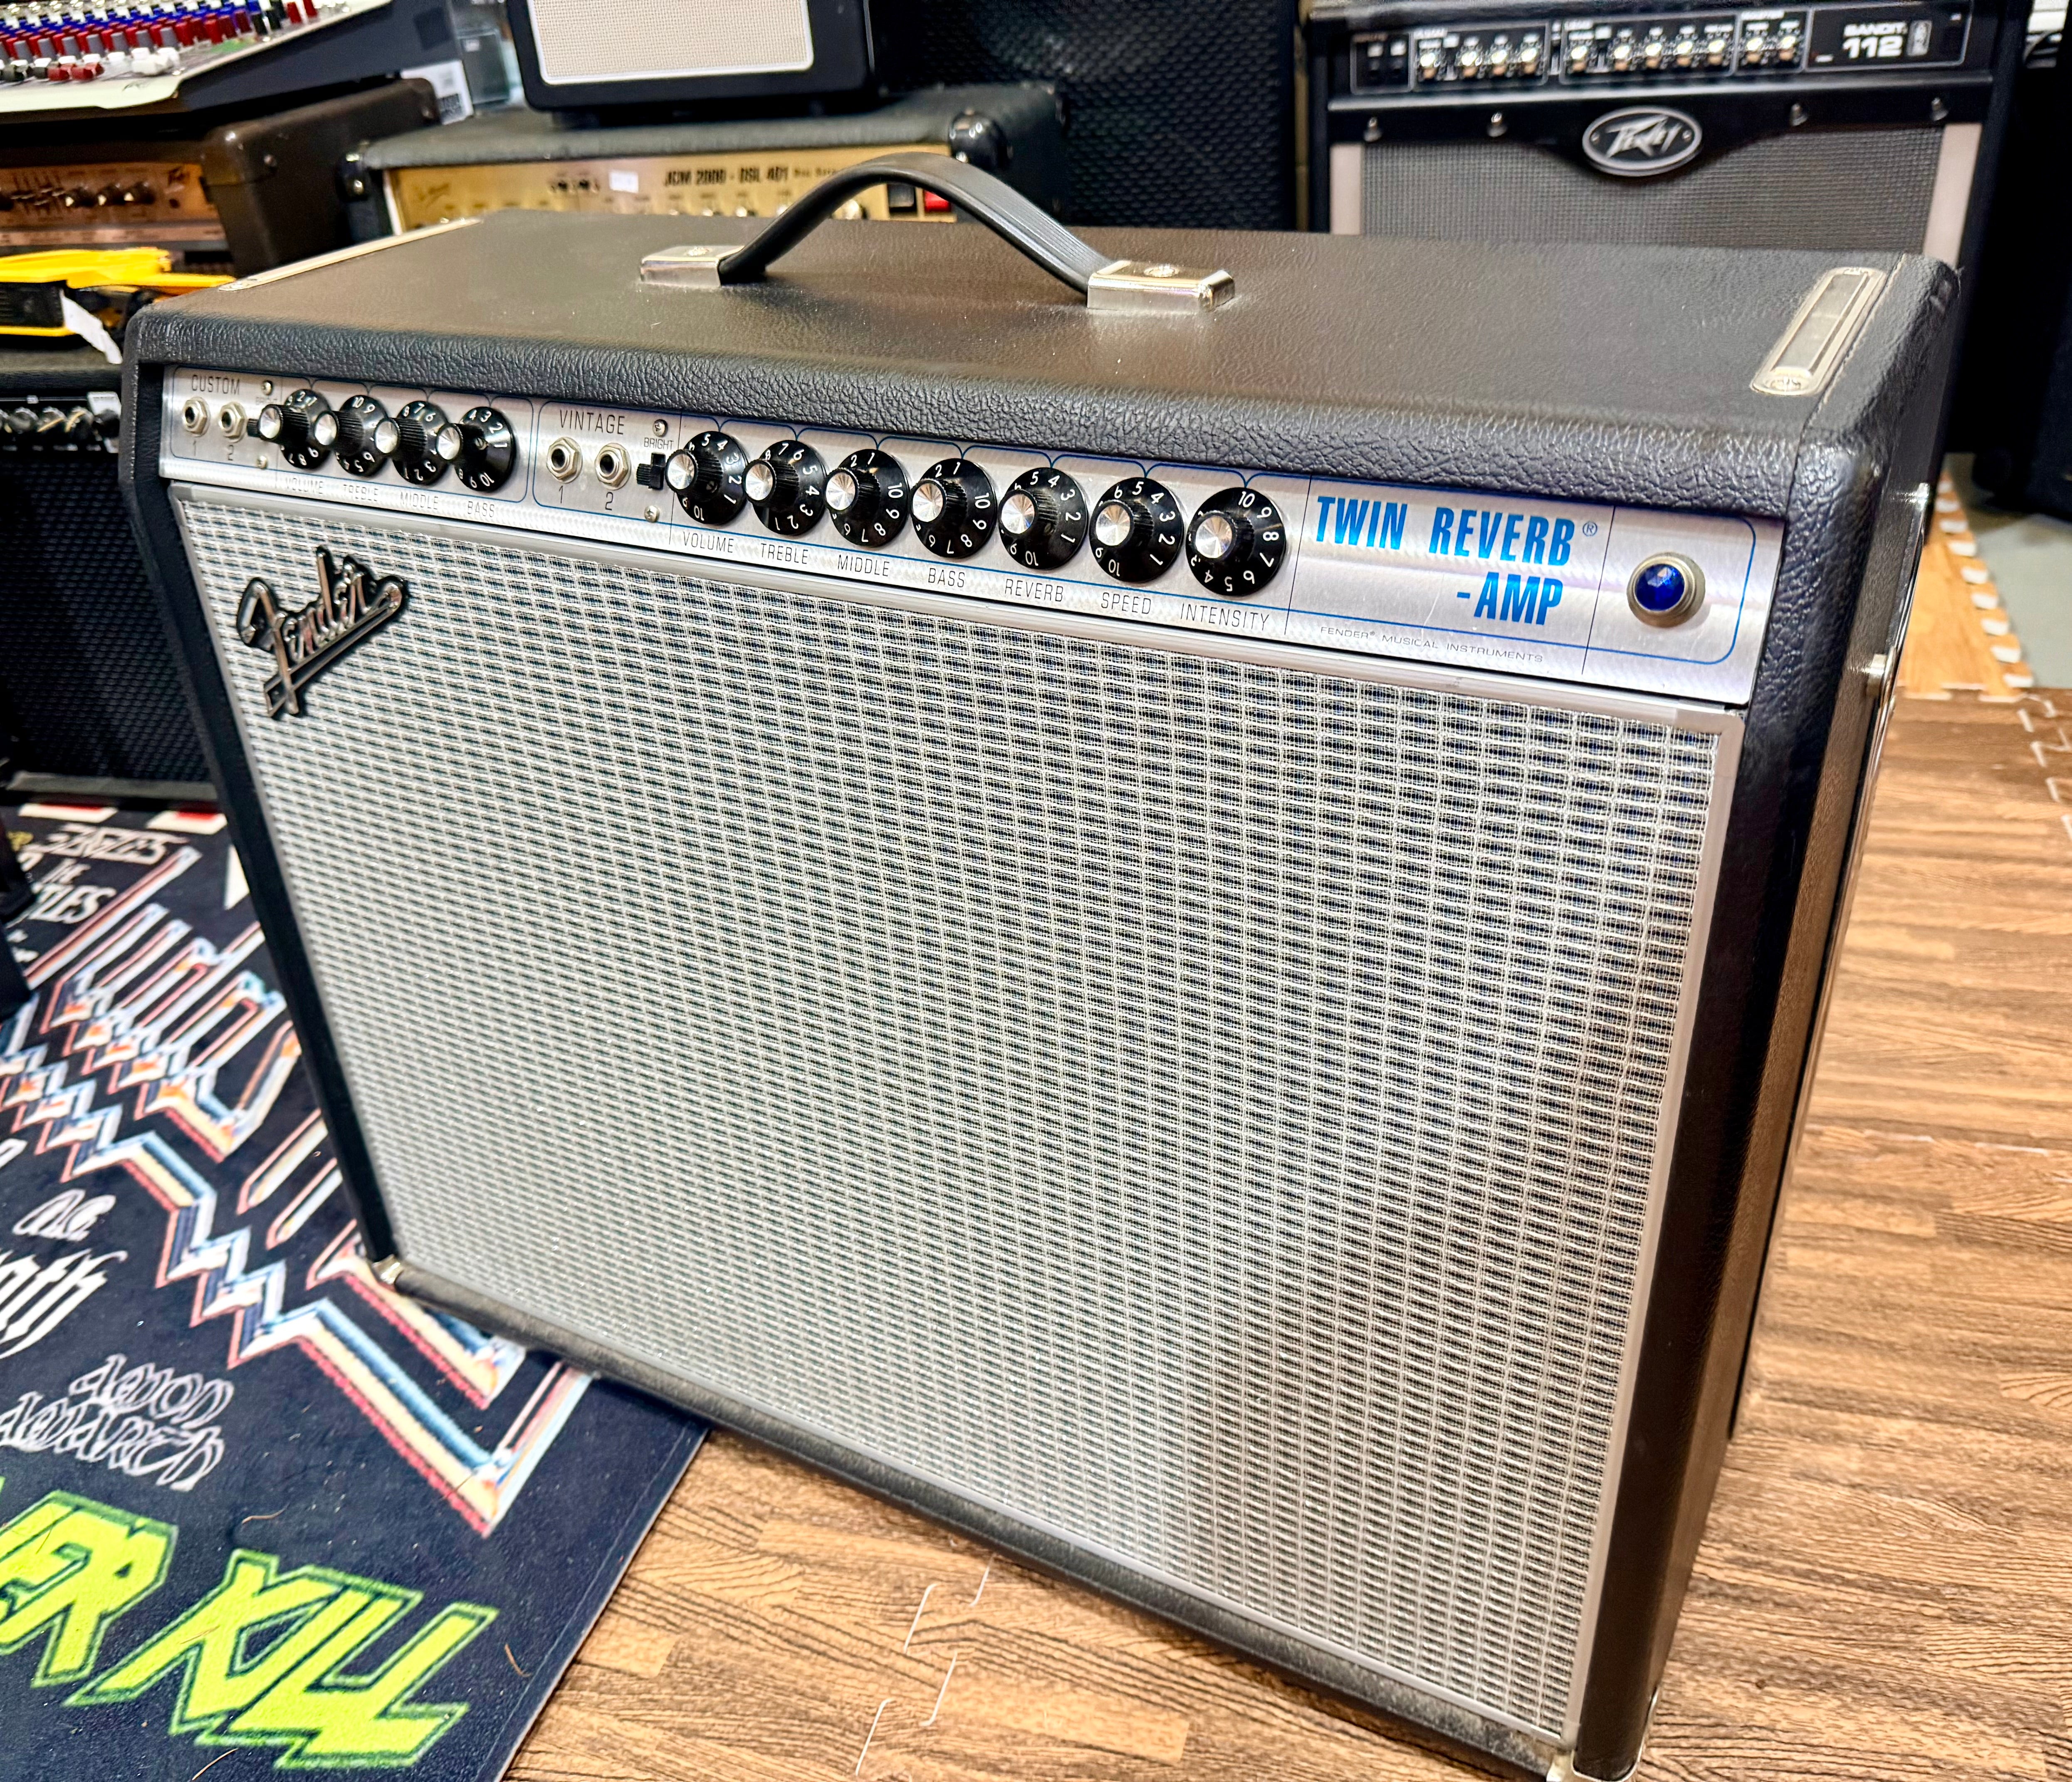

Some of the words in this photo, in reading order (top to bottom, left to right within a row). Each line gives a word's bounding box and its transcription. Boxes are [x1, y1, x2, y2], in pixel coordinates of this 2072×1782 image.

[1842, 35, 1904, 59] 112
[191, 374, 240, 395] CUSTOM
[297, 391, 306, 402] 2
[352, 396, 364, 408] 10
[469, 409, 477, 421] 4
[480, 410, 492, 422] 3
[489, 422, 503, 434] 2
[560, 410, 625, 435] VINTAGE
[414, 403, 425, 414] 7
[423, 460, 436, 473] 3
[644, 437, 674, 450] BRIGHT
[701, 433, 711, 447] 5
[192, 440, 197, 457] 1
[226, 444, 235, 461] 2
[717, 440, 728, 451] 4
[778, 443, 789, 456] 7
[298, 453, 307, 466] 8
[726, 452, 740, 465] 3
[793, 448, 805, 461] 6
[850, 454, 858, 468] 2
[867, 452, 875, 465] 1
[802, 465, 818, 475] 5
[935, 464, 942, 478] 2
[953, 461, 961, 475] 1
[480, 472, 495, 487] 10
[728, 475, 742, 486] 2
[1029, 471, 1039, 485] 5
[1047, 474, 1061, 488] 4
[559, 485, 564, 504] 1
[805, 485, 820, 496] 4
[887, 482, 904, 499] 10
[1060, 488, 1076, 501] 3
[1132, 481, 1144, 495] 5
[400, 492, 439, 510] MIDDLE
[605, 492, 614, 511] 2
[723, 494, 737, 505] 1
[974, 492, 991, 510] 10
[1150, 491, 1165, 505] 4
[1238, 491, 1255, 508] 10
[467, 501, 495, 518] BASS
[693, 505, 705, 521] 10
[800, 503, 814, 517] 3
[1159, 511, 1176, 522] 3
[774, 517, 781, 531] 1
[787, 515, 799, 530] 2
[1065, 512, 1081, 522] 2
[1315, 495, 1408, 550] TWIN
[861, 528, 869, 543] 7
[873, 522, 886, 537] 8
[1262, 531, 1280, 542] 8
[682, 531, 734, 553] VOLUME
[960, 533, 973, 548] 8
[1060, 533, 1076, 544] 1
[1158, 533, 1176, 545] 2
[760, 543, 809, 565] TREBLE
[946, 540, 954, 554] 7
[837, 554, 890, 577] MIDDLE
[1025, 550, 1039, 567] 10
[1149, 553, 1164, 566] 1
[1259, 552, 1275, 568] 7
[1108, 559, 1121, 577] 10
[928, 567, 965, 588] BASS
[1204, 569, 1214, 584] 4
[1004, 578, 1064, 602] REVERB
[1224, 576, 1233, 592] 5
[1100, 592, 1152, 615] SPEED
[1180, 603, 1270, 631] INTENSITY
[236, 544, 407, 719] Fender
[1382, 634, 1438, 649] MUSICAL
[1446, 643, 1543, 663] INSTRUMENTS
